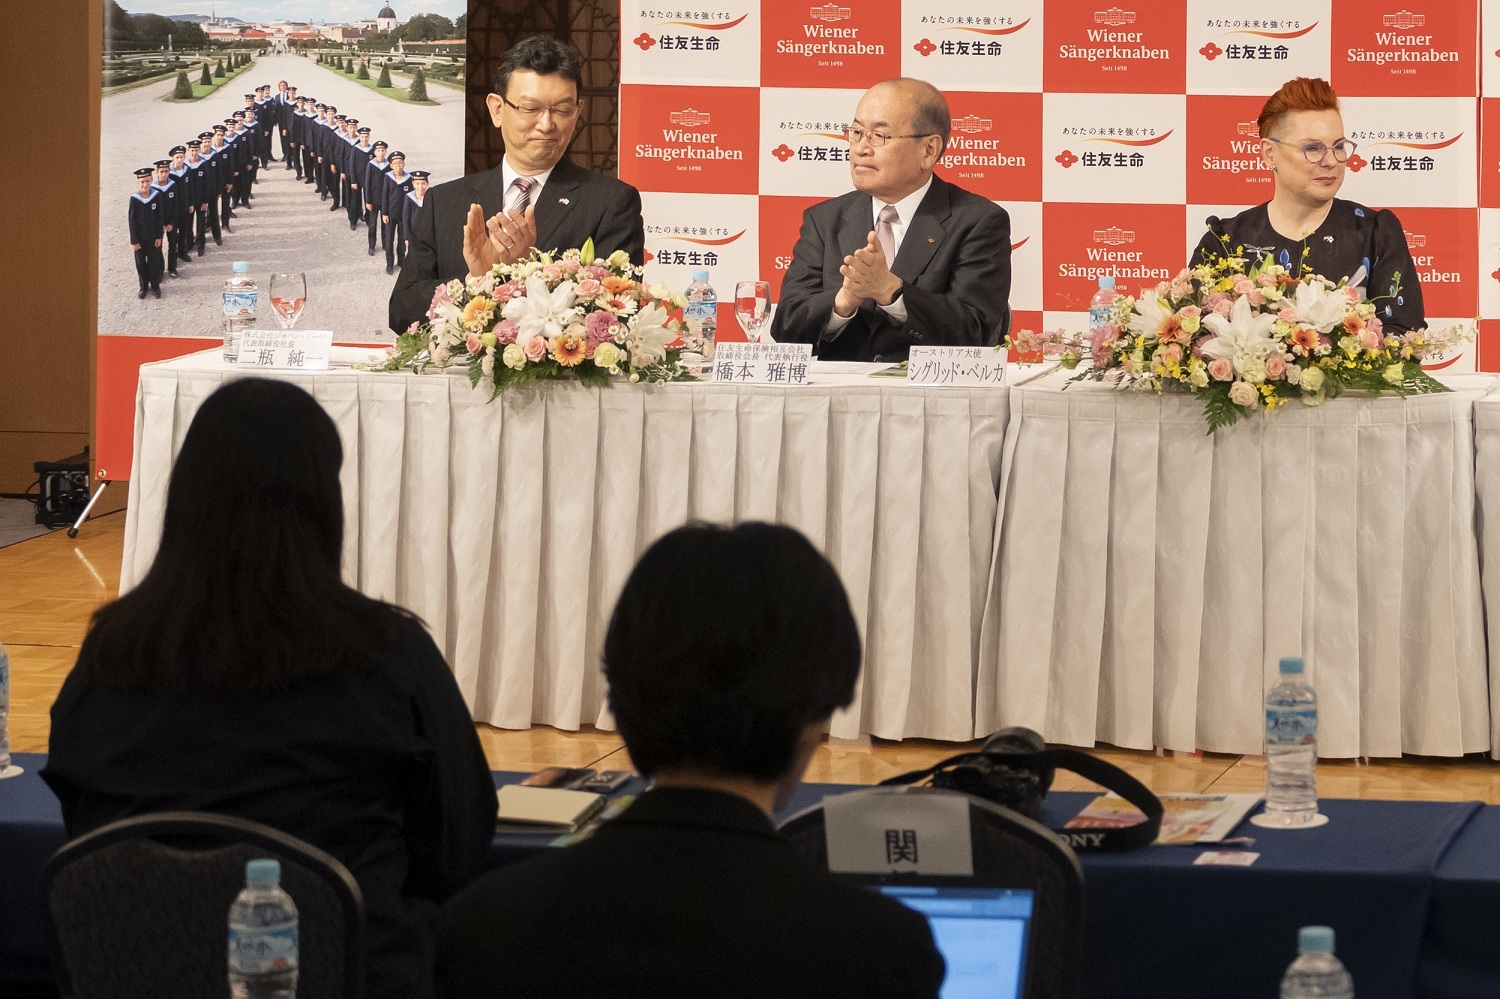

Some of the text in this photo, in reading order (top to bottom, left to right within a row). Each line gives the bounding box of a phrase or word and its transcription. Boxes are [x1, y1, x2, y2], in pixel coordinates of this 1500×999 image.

[640, 10, 730, 20] あなたの未来を強くする
[802, 24, 859, 39] Wiener
[1086, 28, 1144, 43] Wiener
[1374, 31, 1433, 46] Wiener
[658, 34, 721, 51] 住友生命
[776, 39, 885, 57] Sängerknaben
[939, 40, 1003, 57] 住友生命
[1059, 44, 1170, 62] Sängerknaben
[1225, 43, 1289, 60] 住友生命
[1347, 48, 1460, 66] Sängerknaben
[662, 129, 718, 144] Wiener
[635, 144, 743, 162] Sängerknaben
[1081, 151, 1145, 168] 住友生命
[1370, 155, 1435, 171] 住友生命
[656, 249, 718, 267] 住友生命
[1085, 247, 1143, 262] Wiener
[1058, 263, 1170, 281] Sängerknaben
[243, 339, 296, 349] 代表取締役社長
[717, 343, 806, 354] 住友生命保険相互会社
[240, 348, 276, 366] 二瓶
[716, 351, 760, 361] 取締役会長
[910, 347, 984, 359] オーストリア大使
[714, 361, 808, 384] 橋本 雅博
[909, 361, 1004, 384] シグリッド・ベルカ
[1058, 833, 1107, 848] ONY
[885, 829, 918, 875] 関
